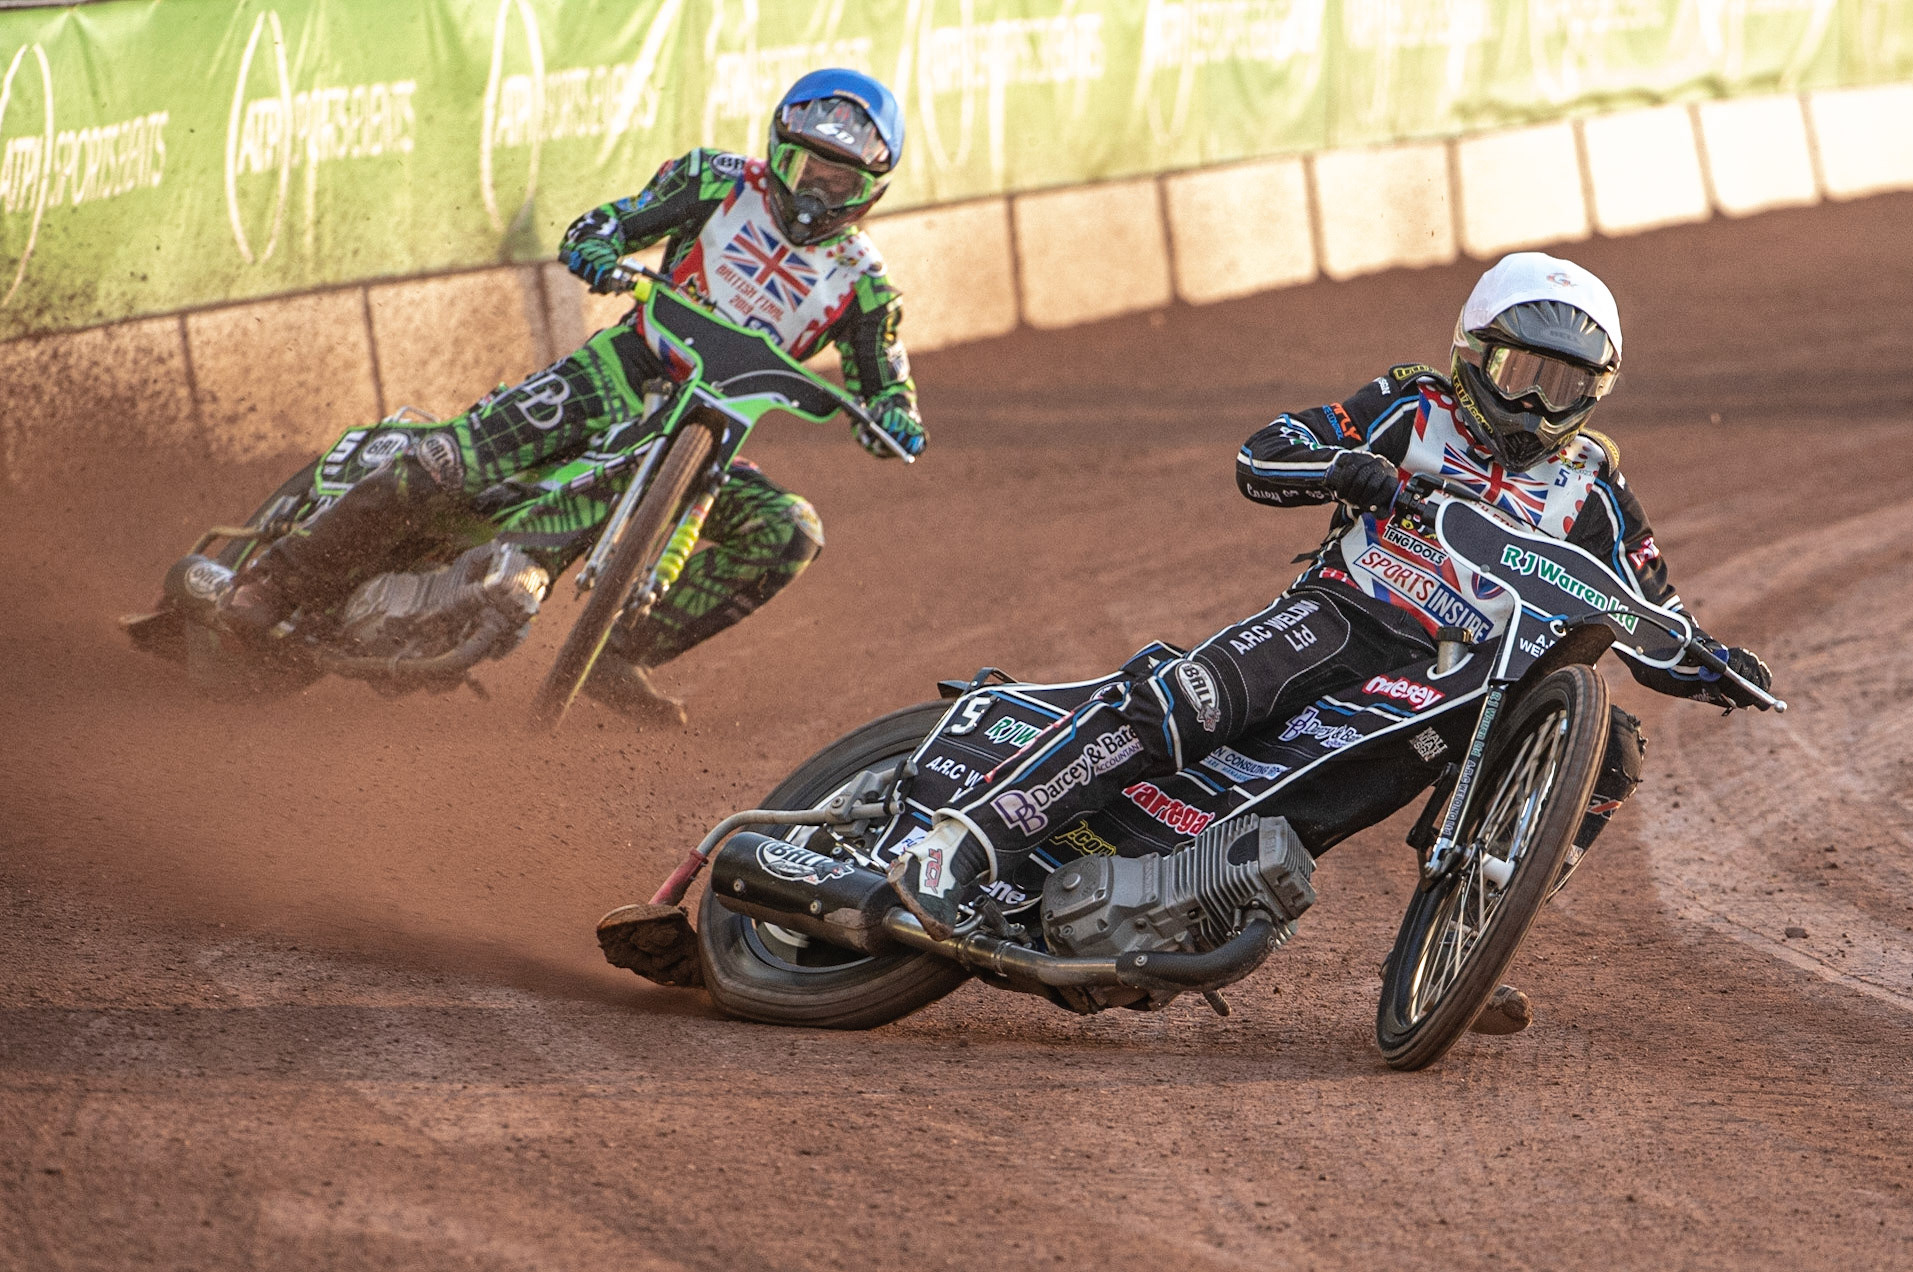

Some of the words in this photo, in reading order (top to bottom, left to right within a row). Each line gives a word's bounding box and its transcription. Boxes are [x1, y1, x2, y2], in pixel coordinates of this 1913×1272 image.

[1361, 552, 1435, 601] SPORTS
[1284, 625, 1318, 652] Ltd
[944, 694, 993, 736] 5
[925, 756, 966, 779] A.R.C
[1033, 760, 1092, 807] Darcey
[1085, 746, 1104, 766] &
